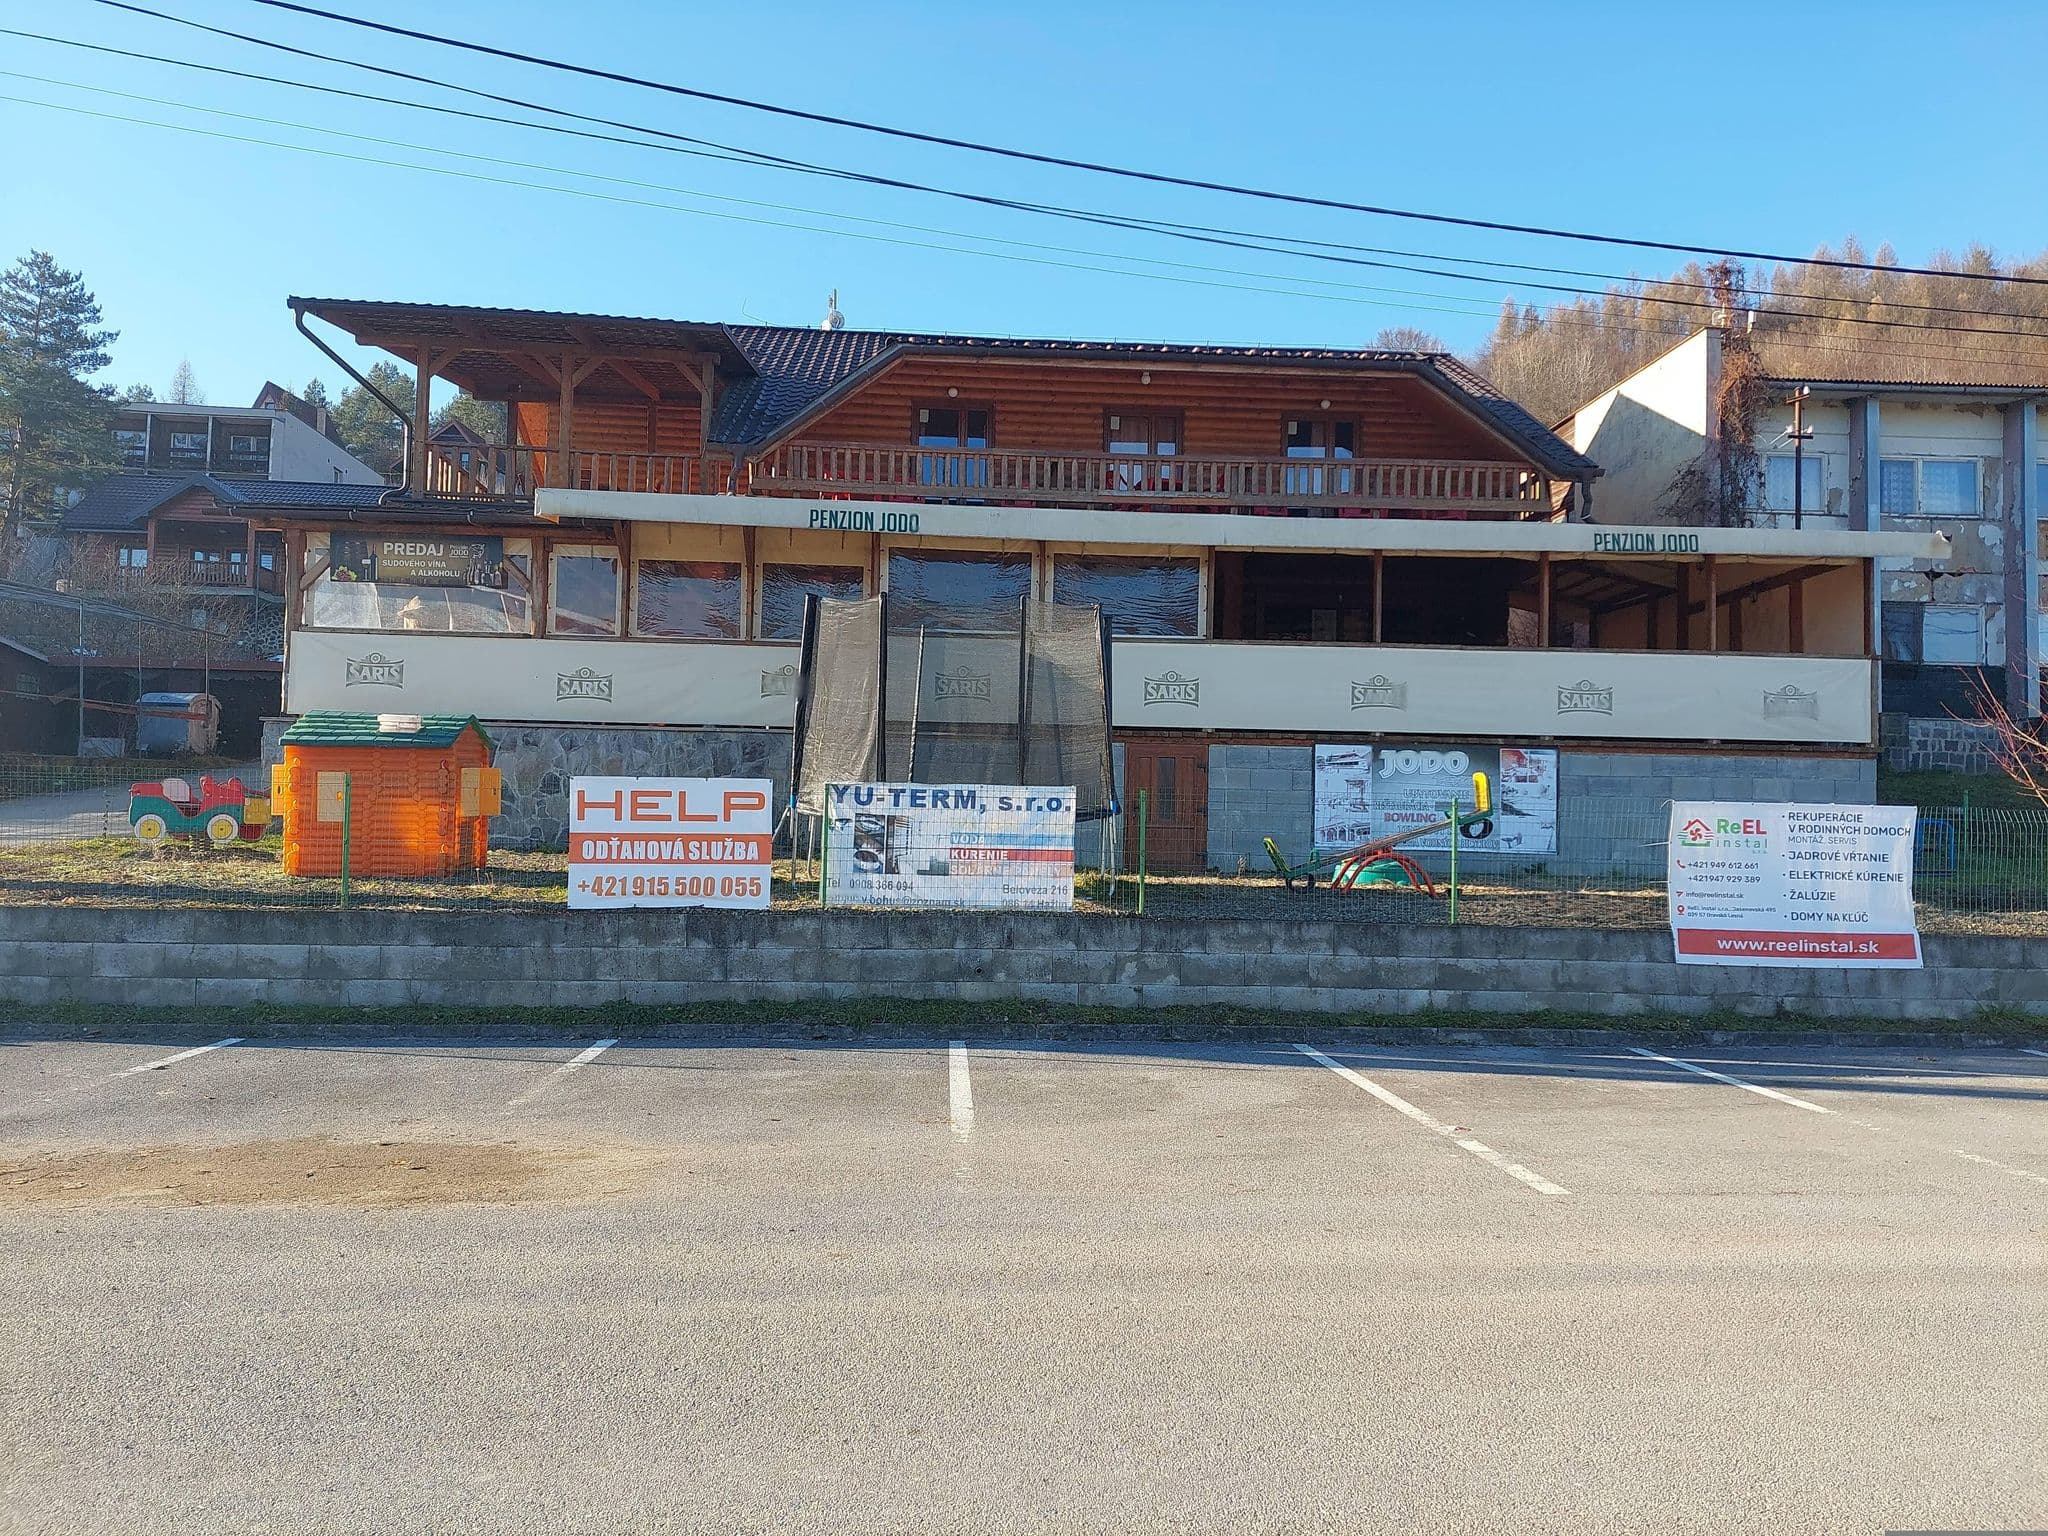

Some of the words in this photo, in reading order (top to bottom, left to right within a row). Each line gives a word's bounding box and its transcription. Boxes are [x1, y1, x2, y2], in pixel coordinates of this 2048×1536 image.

[809, 509, 874, 531] PENZION
[879, 512, 920, 533] JODO
[383, 542, 444, 557] PREDAJ
[1594, 532, 1654, 552] PENZION
[1657, 533, 1699, 553] JODO
[382, 558, 425, 568] SUDOVÉHO
[427, 559, 446, 568] VÍNA
[418, 569, 460, 578] ALKOHOLU
[1379, 750, 1469, 778] JODO
[831, 783, 987, 814] YU-TERM,
[998, 796, 1071, 812] s.r.o.
[577, 790, 766, 822] HELP
[1384, 812, 1436, 823] BOWLING
[1788, 811, 1863, 823] REKUPERÁCIE
[1717, 818, 1767, 835] ReEL
[1788, 824, 1796, 833] V
[1798, 823, 1861, 835] RODINNÝCH
[1864, 826, 1911, 837] DOMOCH
[1716, 838, 1768, 849] instal
[1828, 836, 1857, 845] SERVIS
[582, 837, 685, 861] ODŤAHOVÁ
[688, 837, 759, 861] SLUŽBA
[1788, 849, 1840, 861] JADROVÉ
[1842, 850, 1889, 863] VŔTANIE
[1728, 862, 1742, 870] 612
[1744, 862, 1759, 870] 661
[1789, 869, 1854, 881] ELEKTRICKÉ
[1856, 871, 1905, 883] KÚRENIE
[577, 876, 627, 897] +421
[632, 876, 669, 897] 915
[674, 876, 716, 897] 500
[720, 876, 762, 897] 055
[876, 881, 893, 891] 366
[1050, 885, 1068, 896] 216
[1789, 888, 1836, 901] ŽALÚZIE
[1791, 911, 1824, 921] DOMY
[1826, 912, 1840, 922] NA
[1717, 937, 1879, 954] www.reelinstal.sk
